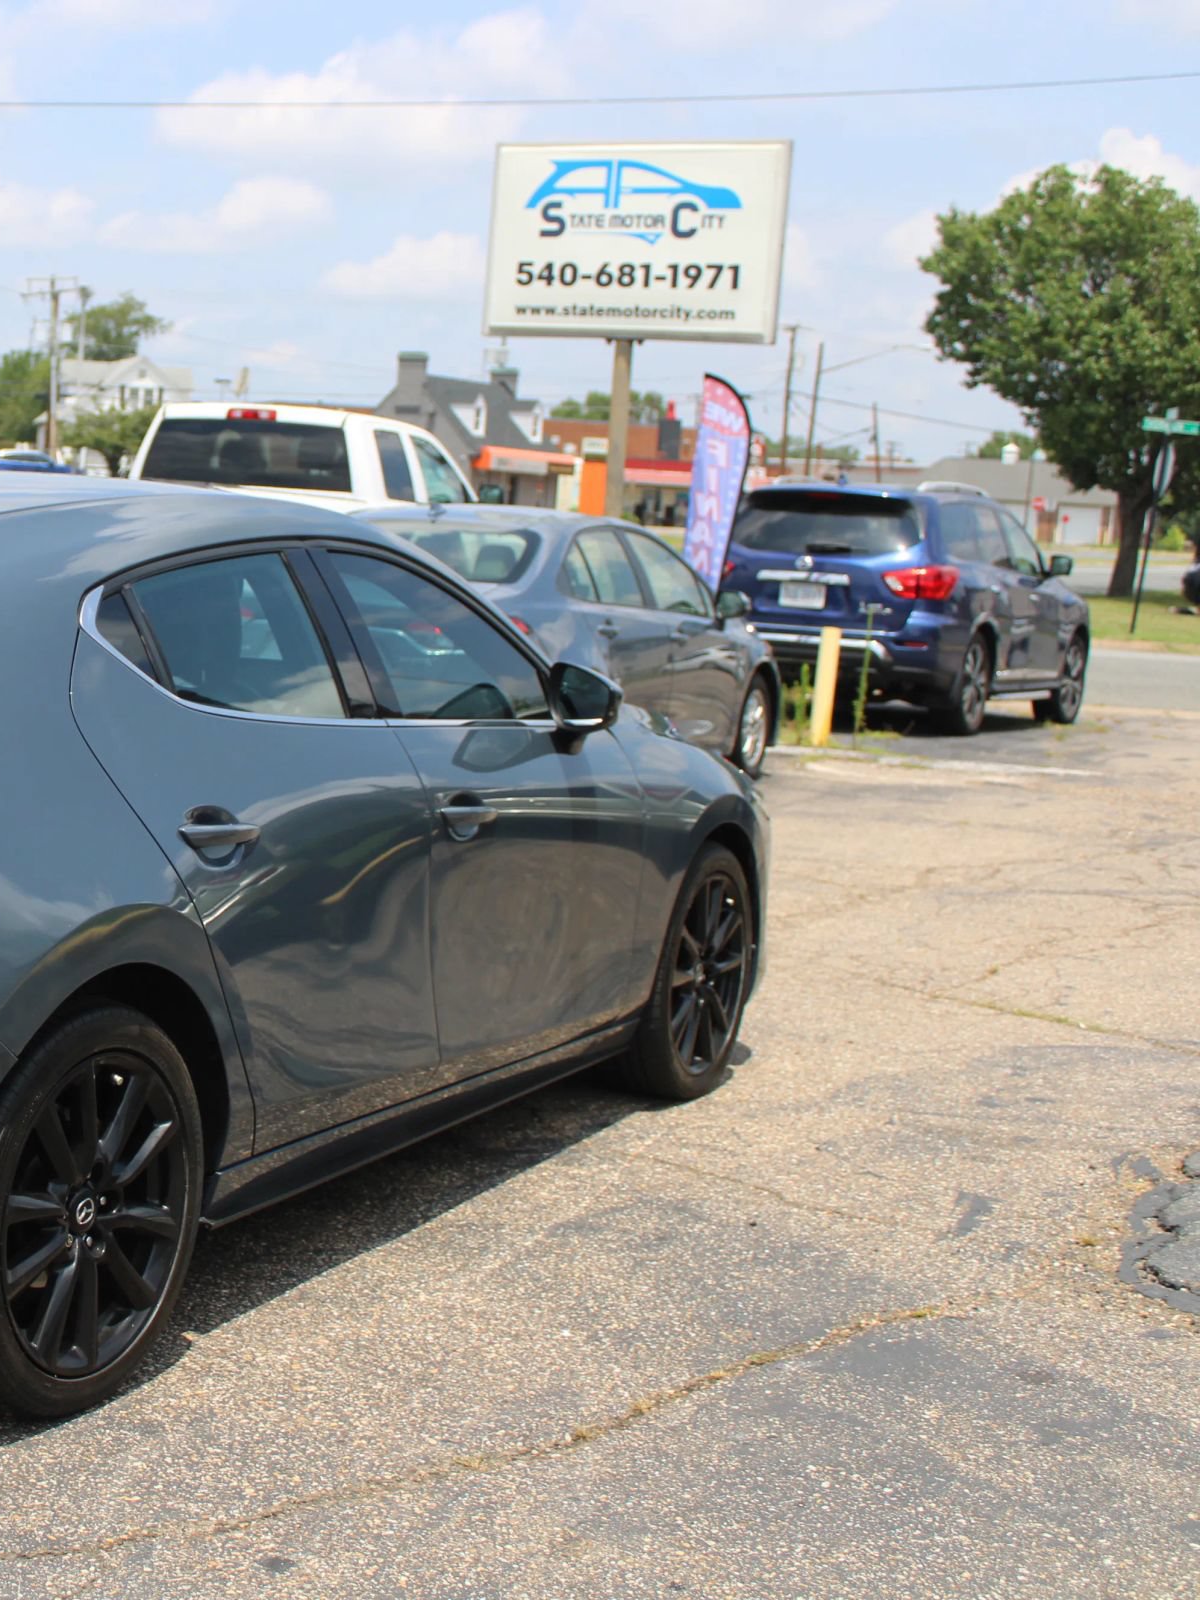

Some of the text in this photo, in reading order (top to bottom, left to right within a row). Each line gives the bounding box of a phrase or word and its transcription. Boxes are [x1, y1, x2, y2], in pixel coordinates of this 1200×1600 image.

[540, 202, 725, 238] STATE MOTOR CITY
[516, 262, 740, 289] 540-681-1971
[515, 303, 736, 321] www.statemotorcity.com
